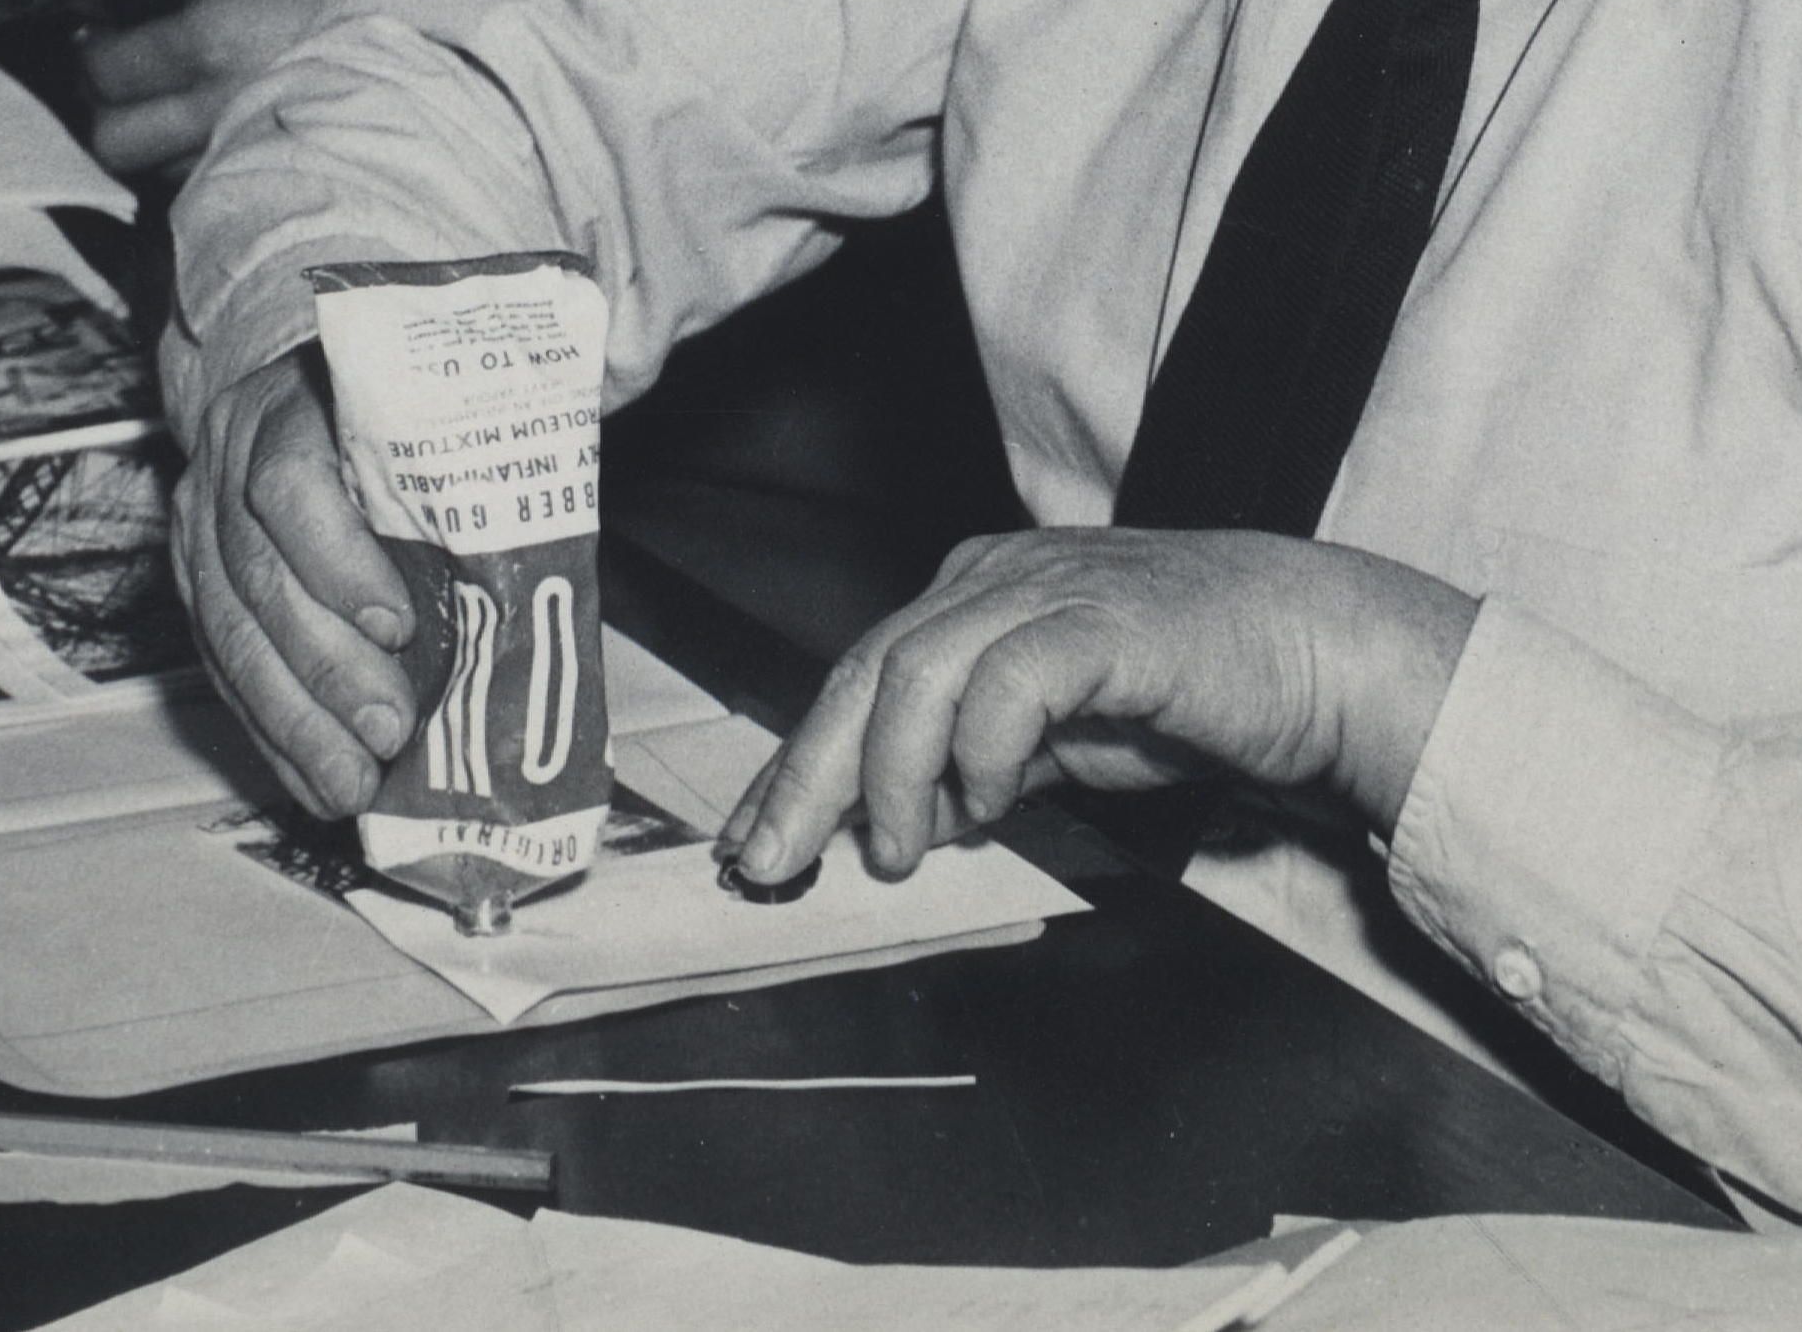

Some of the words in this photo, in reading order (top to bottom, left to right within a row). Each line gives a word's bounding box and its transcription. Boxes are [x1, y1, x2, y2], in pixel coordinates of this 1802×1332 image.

[480, 351, 514, 371] TO
[528, 344, 580, 366] HOW
[387, 425, 502, 459] MIXTURE
[394, 453, 558, 494] INFLAMMABLE
[427, 575, 613, 799] OW
